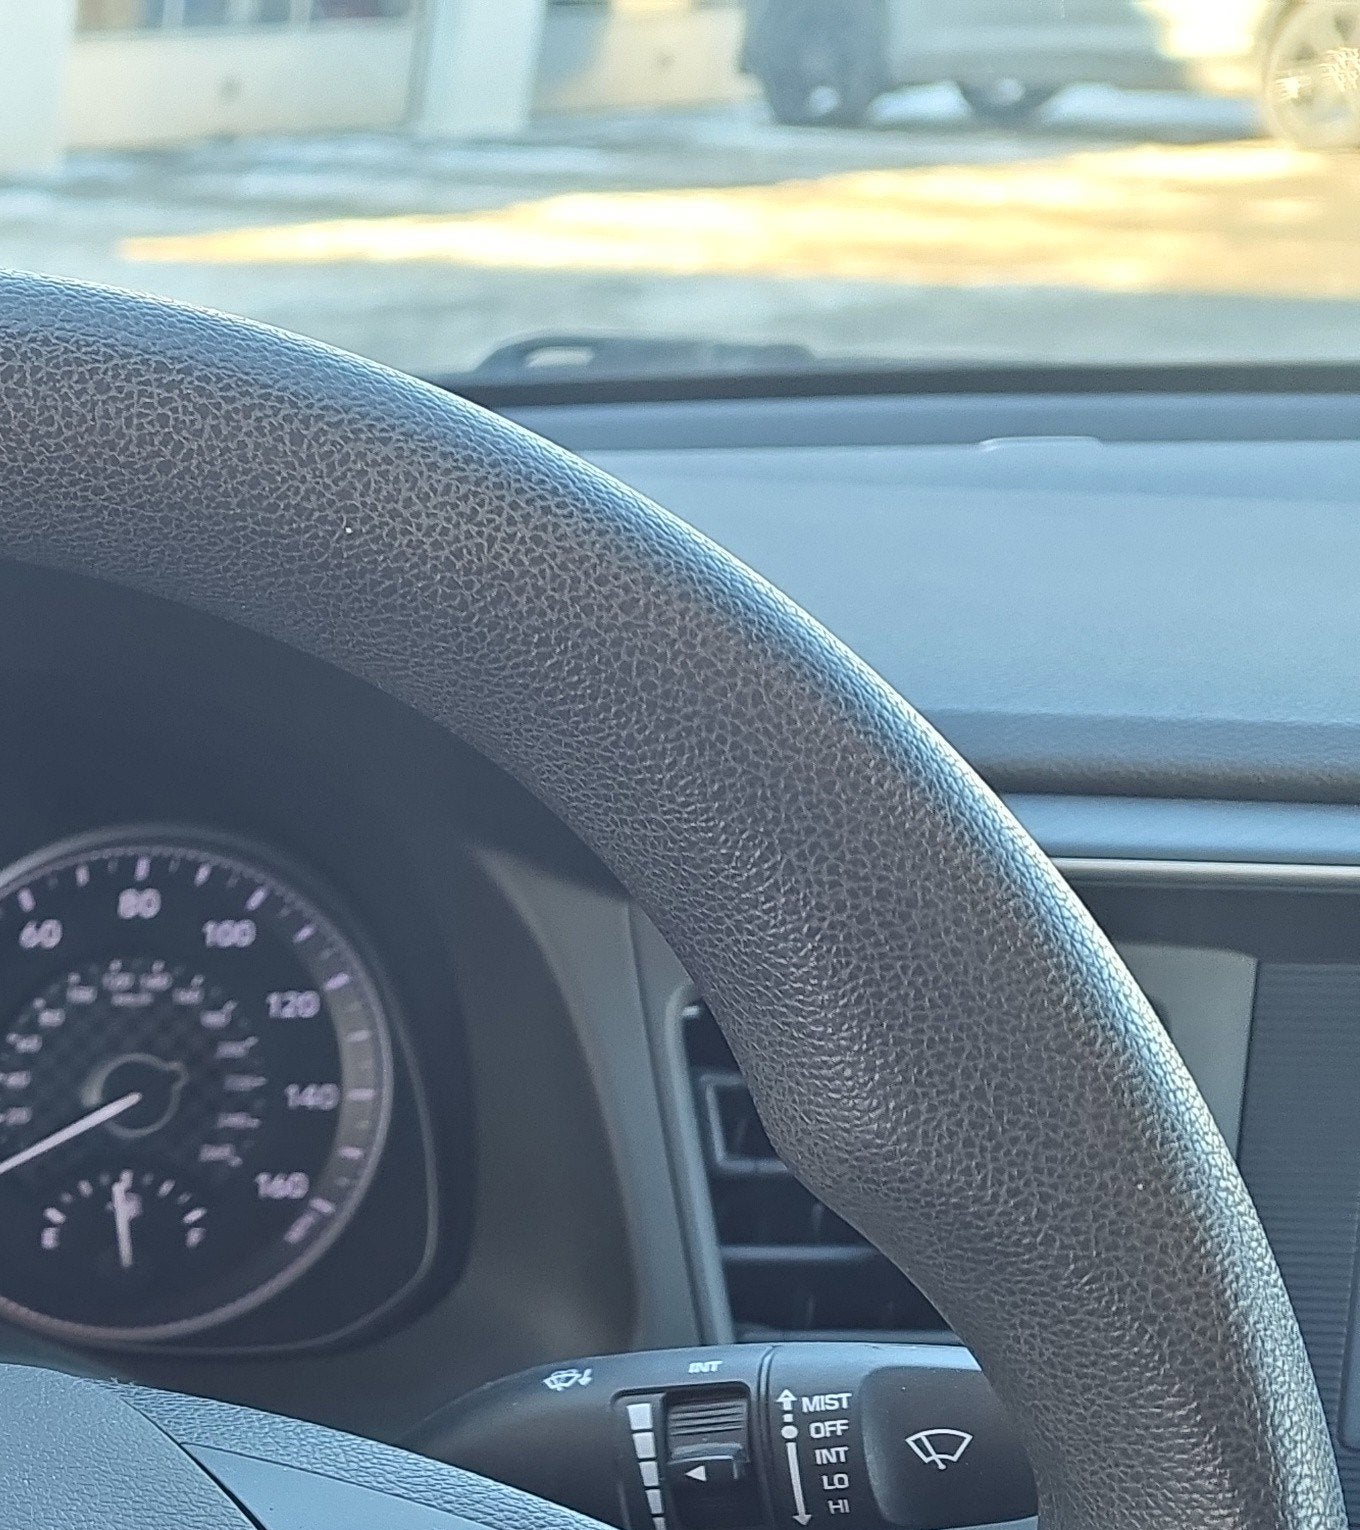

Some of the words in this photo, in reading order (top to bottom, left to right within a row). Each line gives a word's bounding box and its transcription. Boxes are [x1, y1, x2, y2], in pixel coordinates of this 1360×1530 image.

[118, 888, 162, 919] 80
[19, 918, 63, 949] 60
[203, 918, 257, 948] 100
[267, 990, 321, 1019] 120
[285, 1083, 341, 1111] 140
[256, 1171, 310, 1200] 160
[688, 1360, 723, 1374] INT
[801, 1392, 853, 1414] MIST
[809, 1419, 849, 1439] OFF
[814, 1446, 848, 1466] INT
[821, 1472, 849, 1490] LO
[827, 1498, 850, 1515] HI
